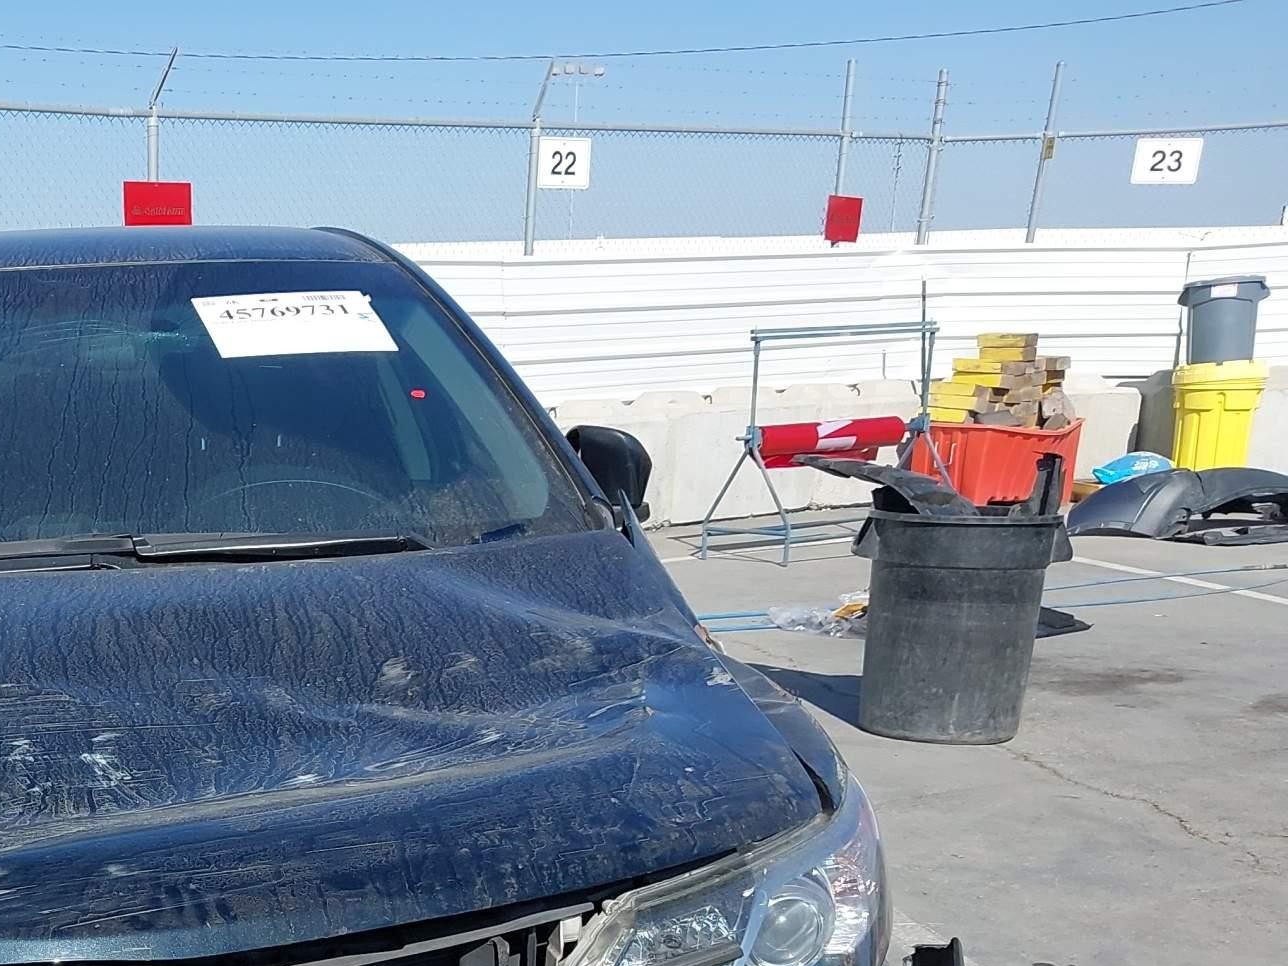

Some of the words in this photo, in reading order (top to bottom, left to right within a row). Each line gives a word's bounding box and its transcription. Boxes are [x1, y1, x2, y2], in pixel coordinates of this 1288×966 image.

[551, 150, 577, 175] 22
[1150, 150, 1183, 172] 23
[219, 304, 349, 320] 45769731
